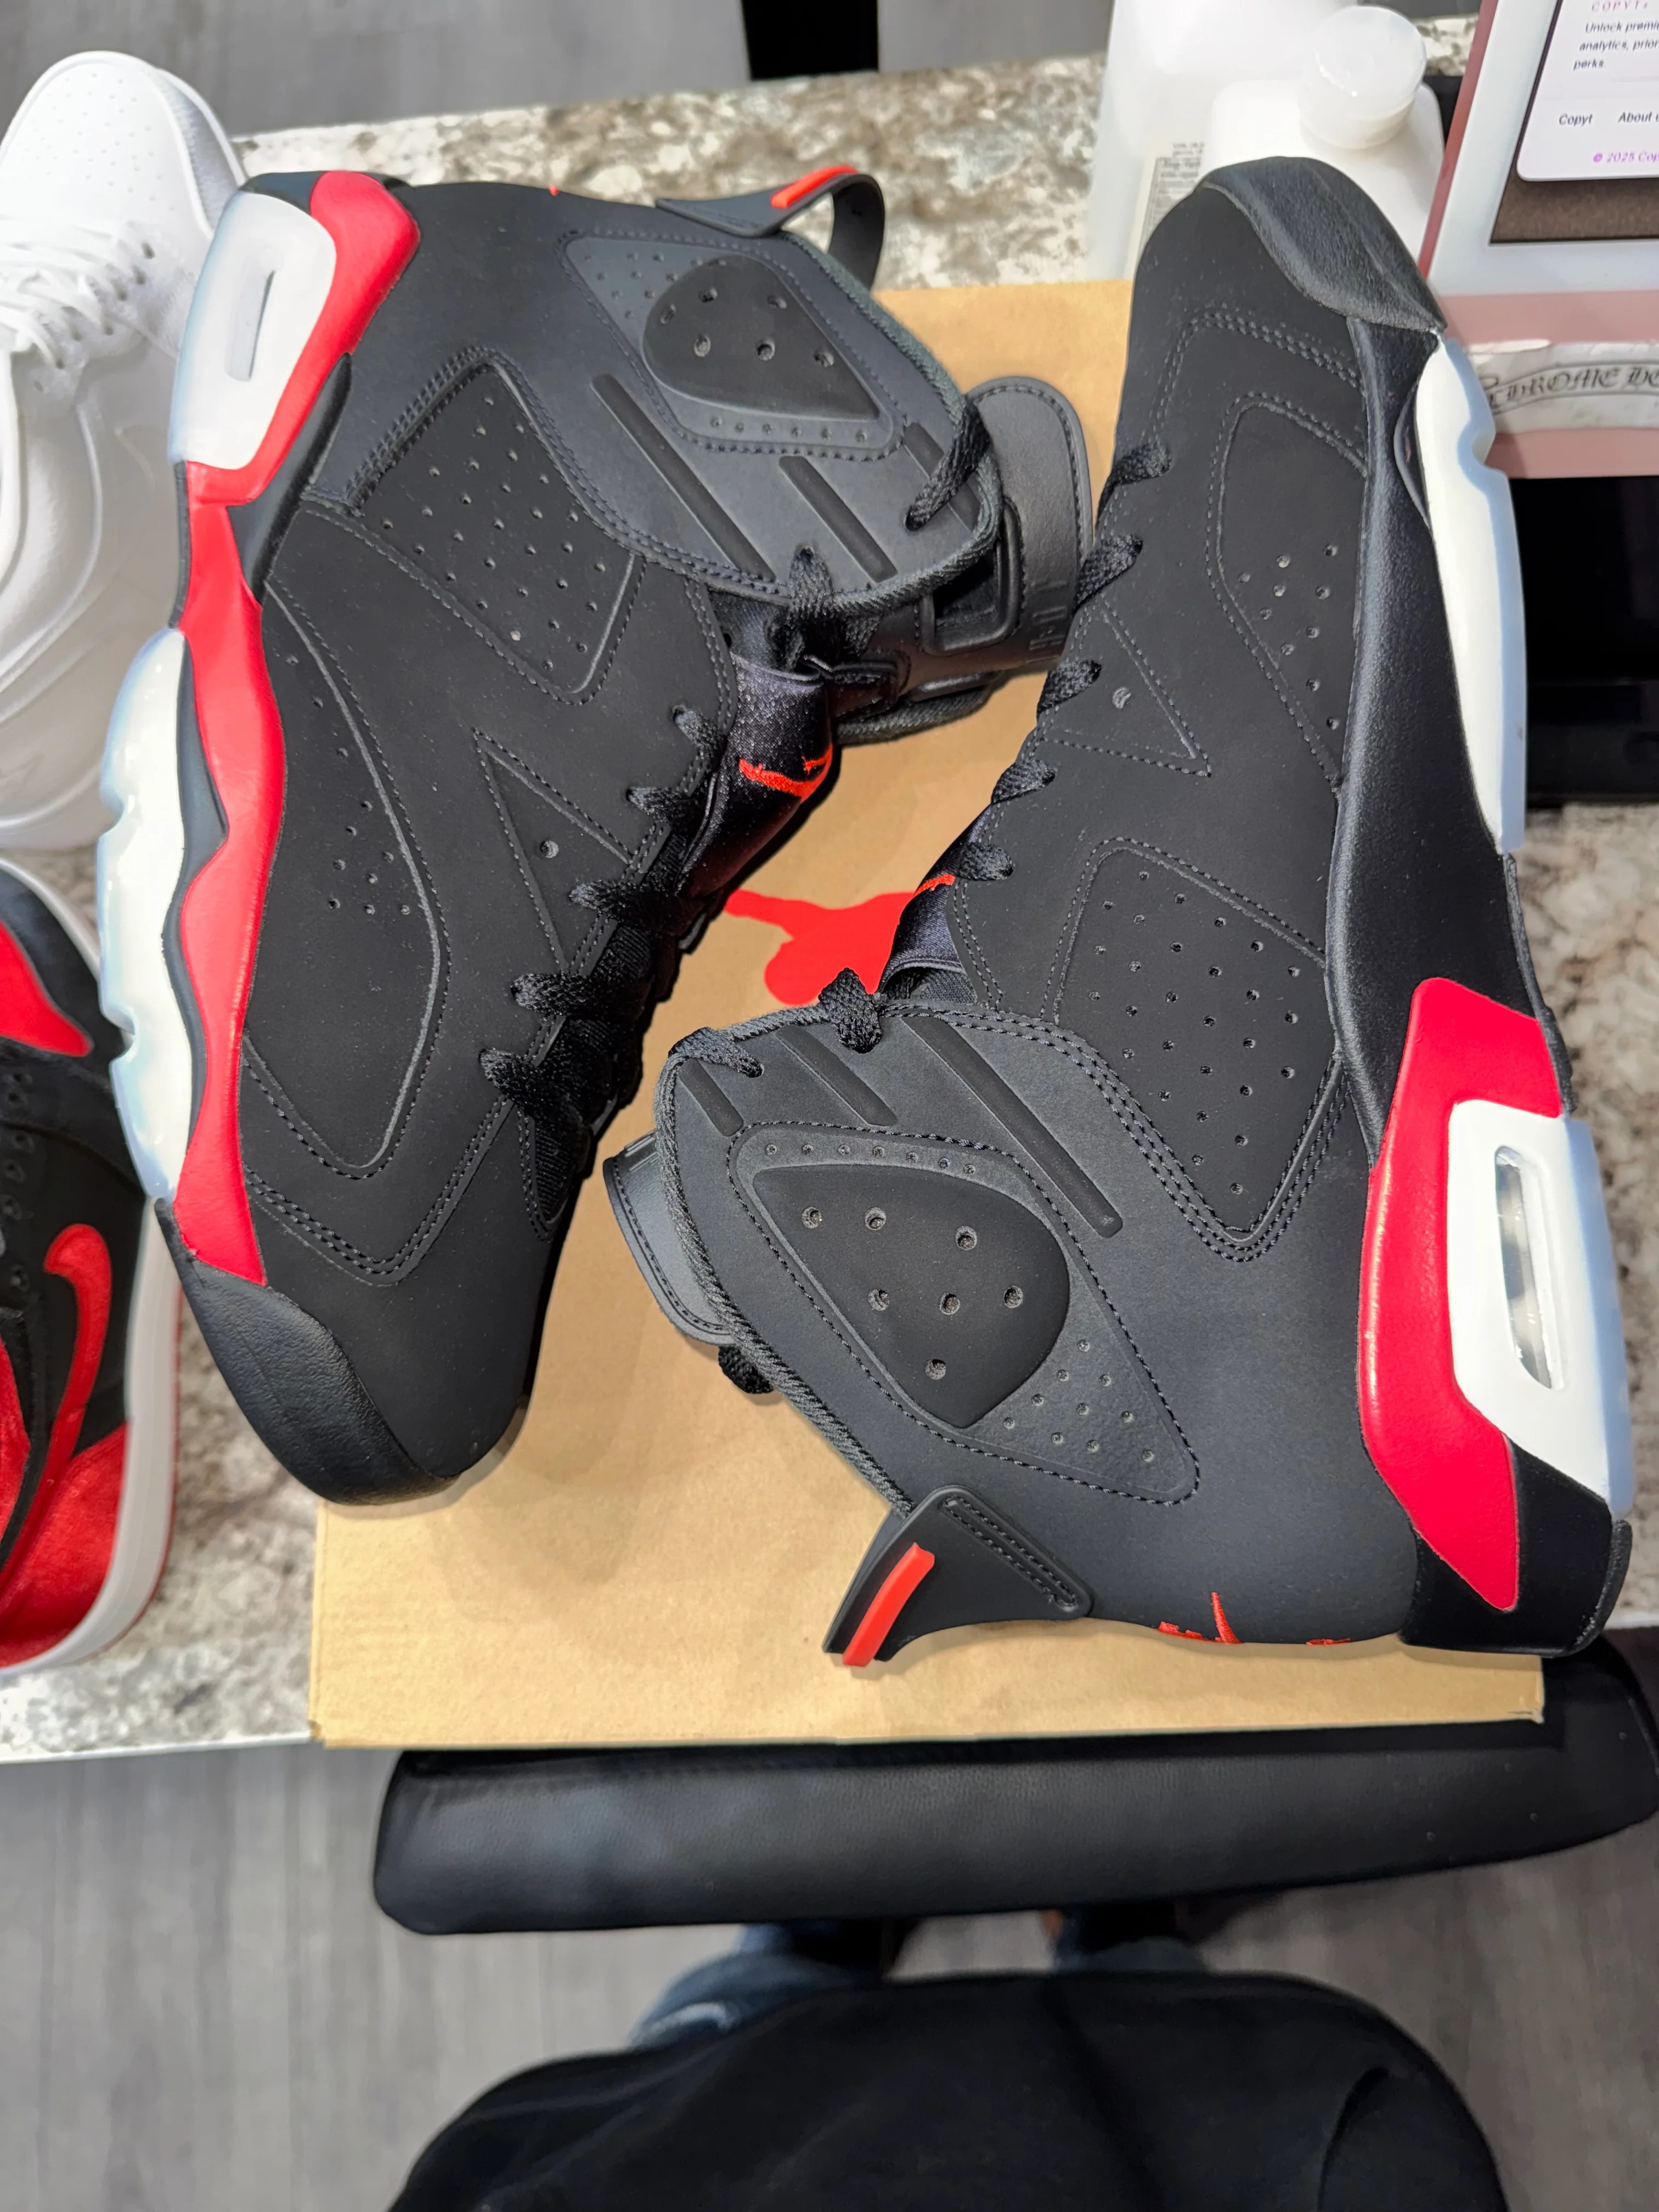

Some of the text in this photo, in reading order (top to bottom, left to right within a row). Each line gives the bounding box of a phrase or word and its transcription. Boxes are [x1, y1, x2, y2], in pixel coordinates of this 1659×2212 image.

[1585, 21, 1622, 33] Unlock
[1579, 40, 1628, 53] analytics,
[1573, 58, 1605, 71] perks.
[1559, 112, 1593, 127] Copyt
[1618, 111, 1652, 123] About
